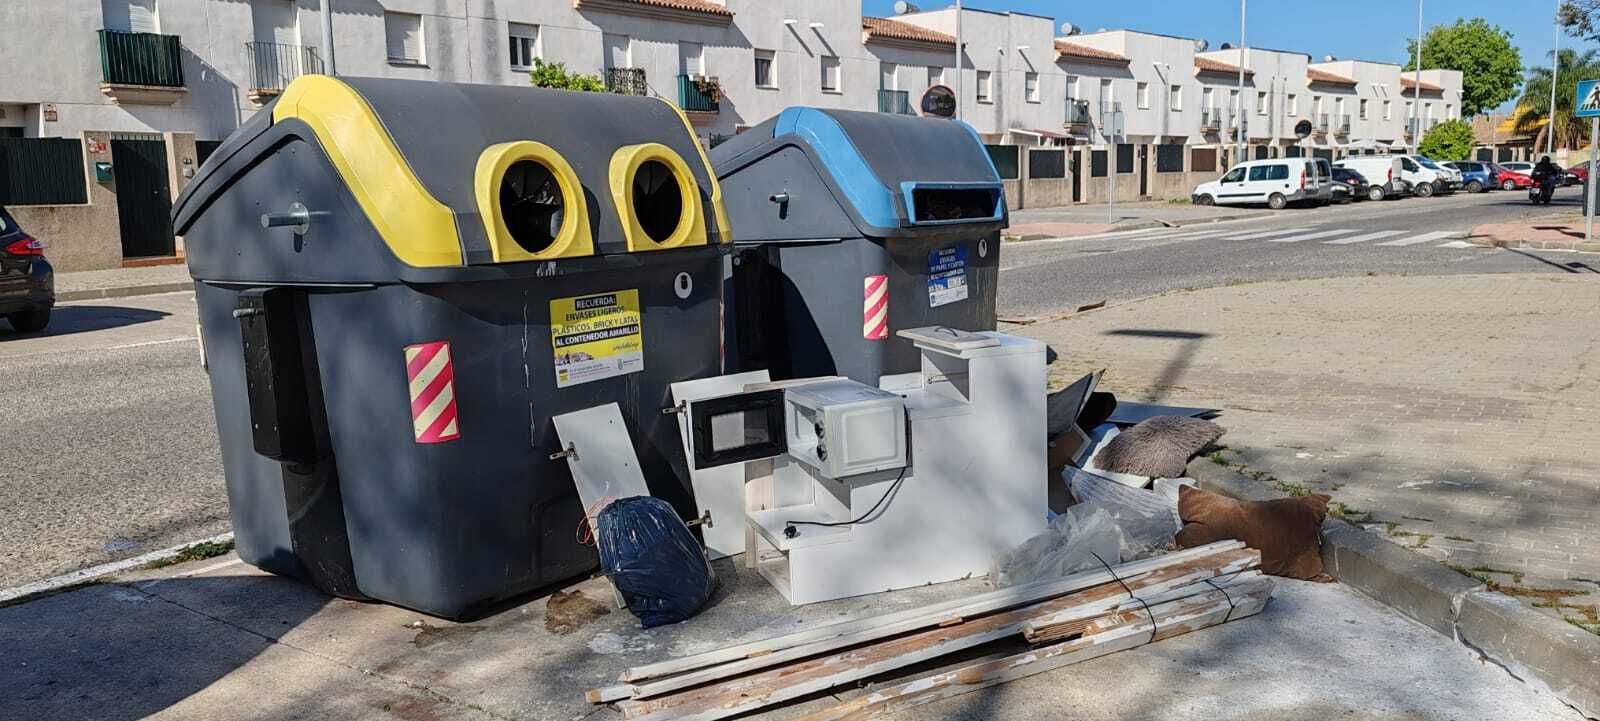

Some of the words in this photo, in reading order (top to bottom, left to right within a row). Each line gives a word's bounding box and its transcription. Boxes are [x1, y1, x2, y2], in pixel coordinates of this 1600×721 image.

[576, 296, 616, 309] RECUERDA:
[566, 310, 596, 321] ENVASES
[597, 305, 625, 317] LIGEROS
[593, 320, 613, 329] BRICK
[619, 316, 638, 325] LATAS
[556, 338, 564, 346] AL
[565, 332, 609, 345] CONTENEDOR
[609, 327, 638, 337] AMARILLO
